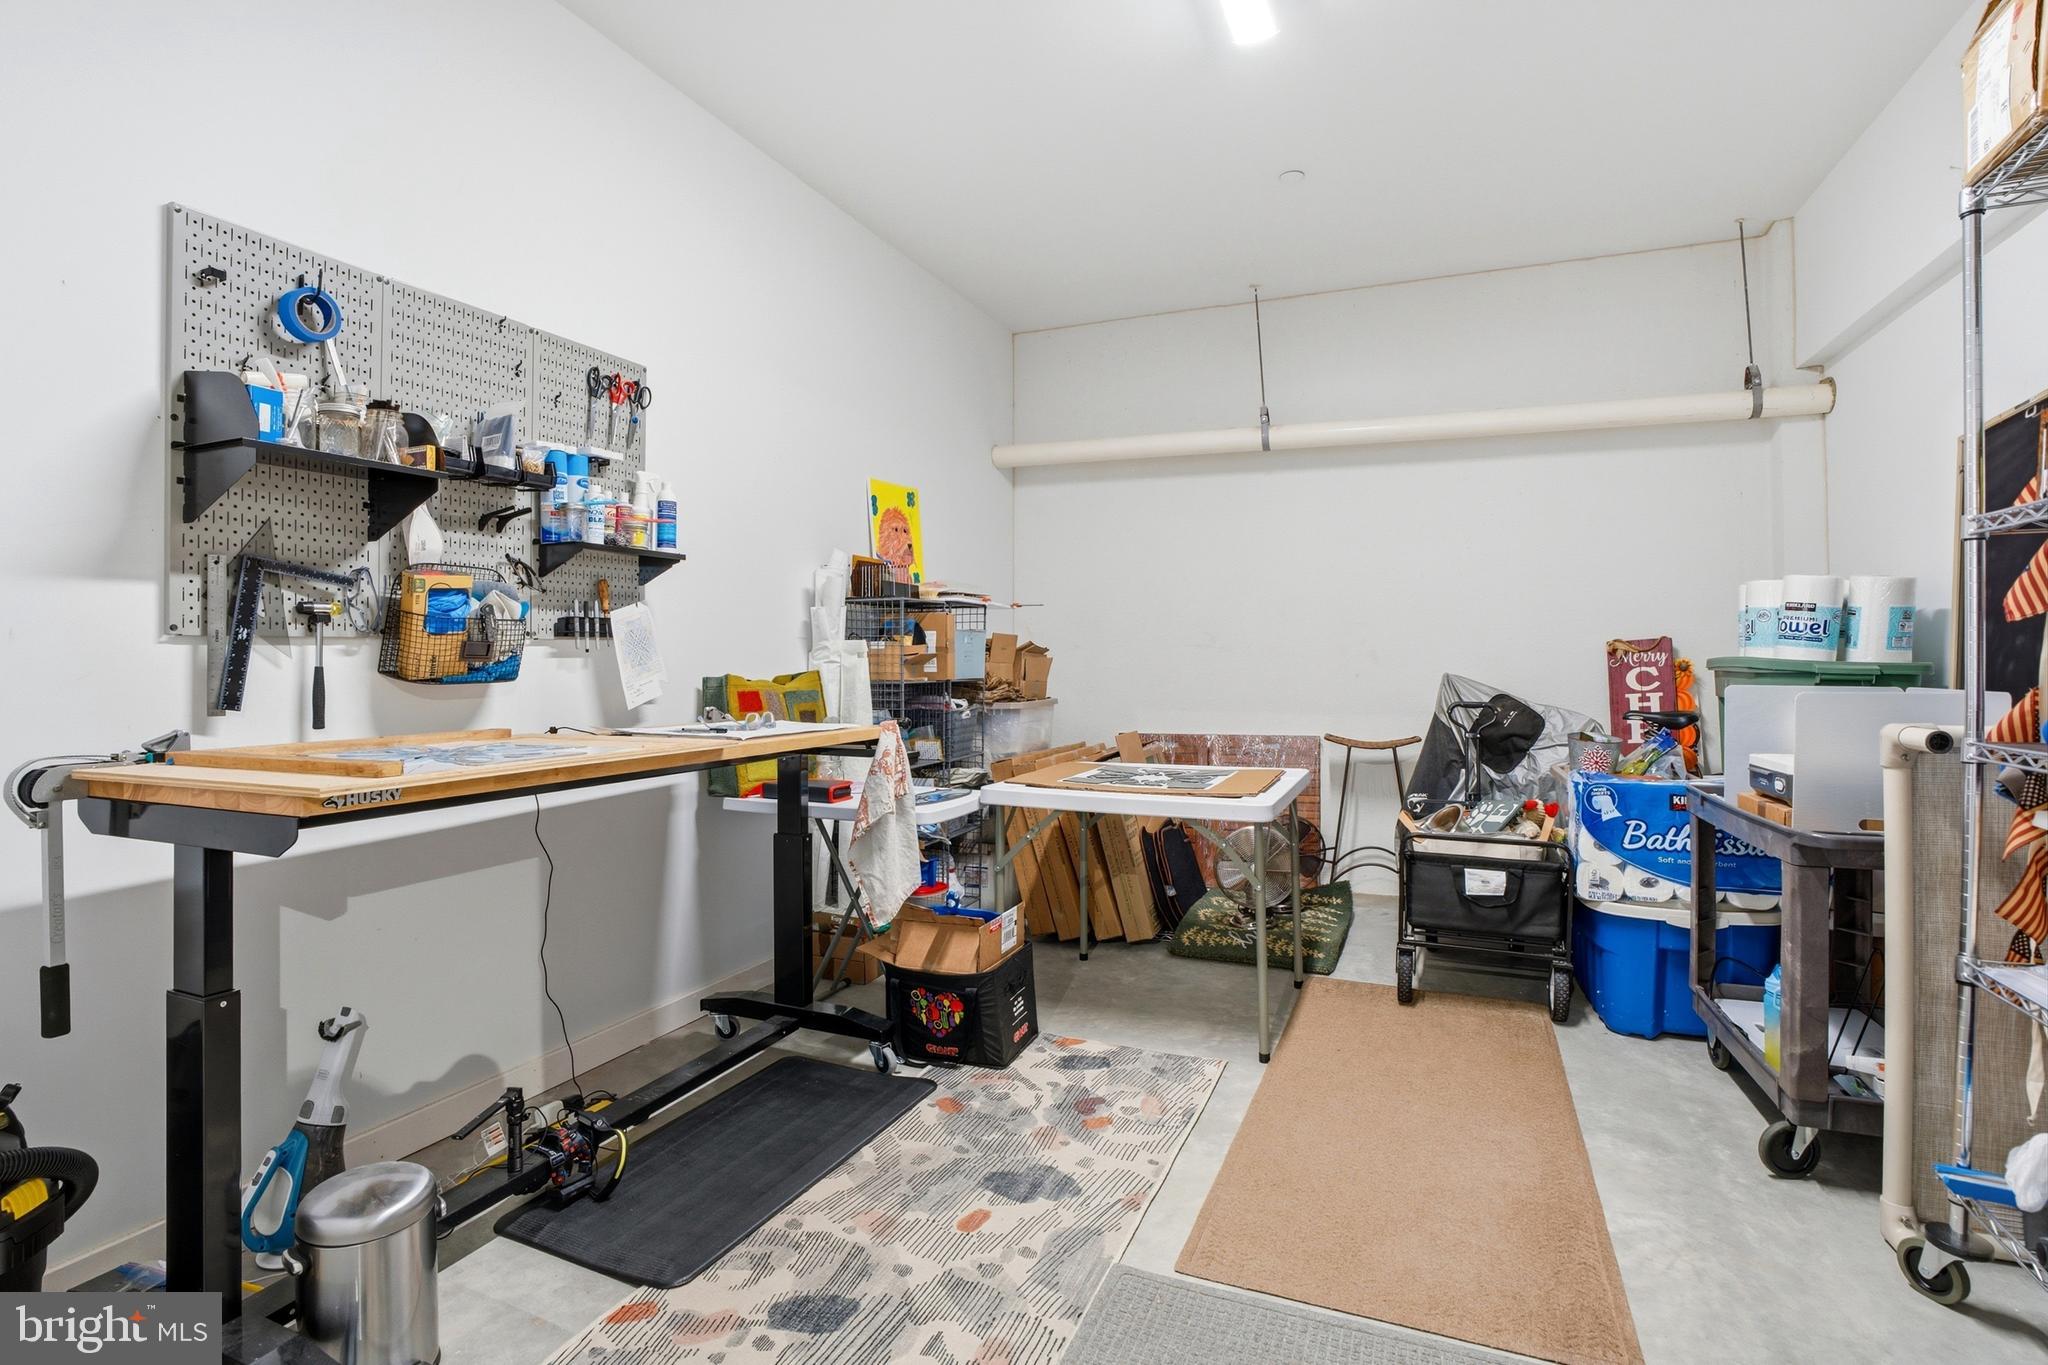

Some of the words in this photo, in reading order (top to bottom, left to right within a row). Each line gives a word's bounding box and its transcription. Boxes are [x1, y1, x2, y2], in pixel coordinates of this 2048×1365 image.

[1778, 619, 1829, 636] owel
[1609, 651, 1669, 668] Merry
[346, 788, 402, 807] HUSKY
[1623, 820, 1691, 850] Bath
[1658, 856, 1675, 864] Soft
